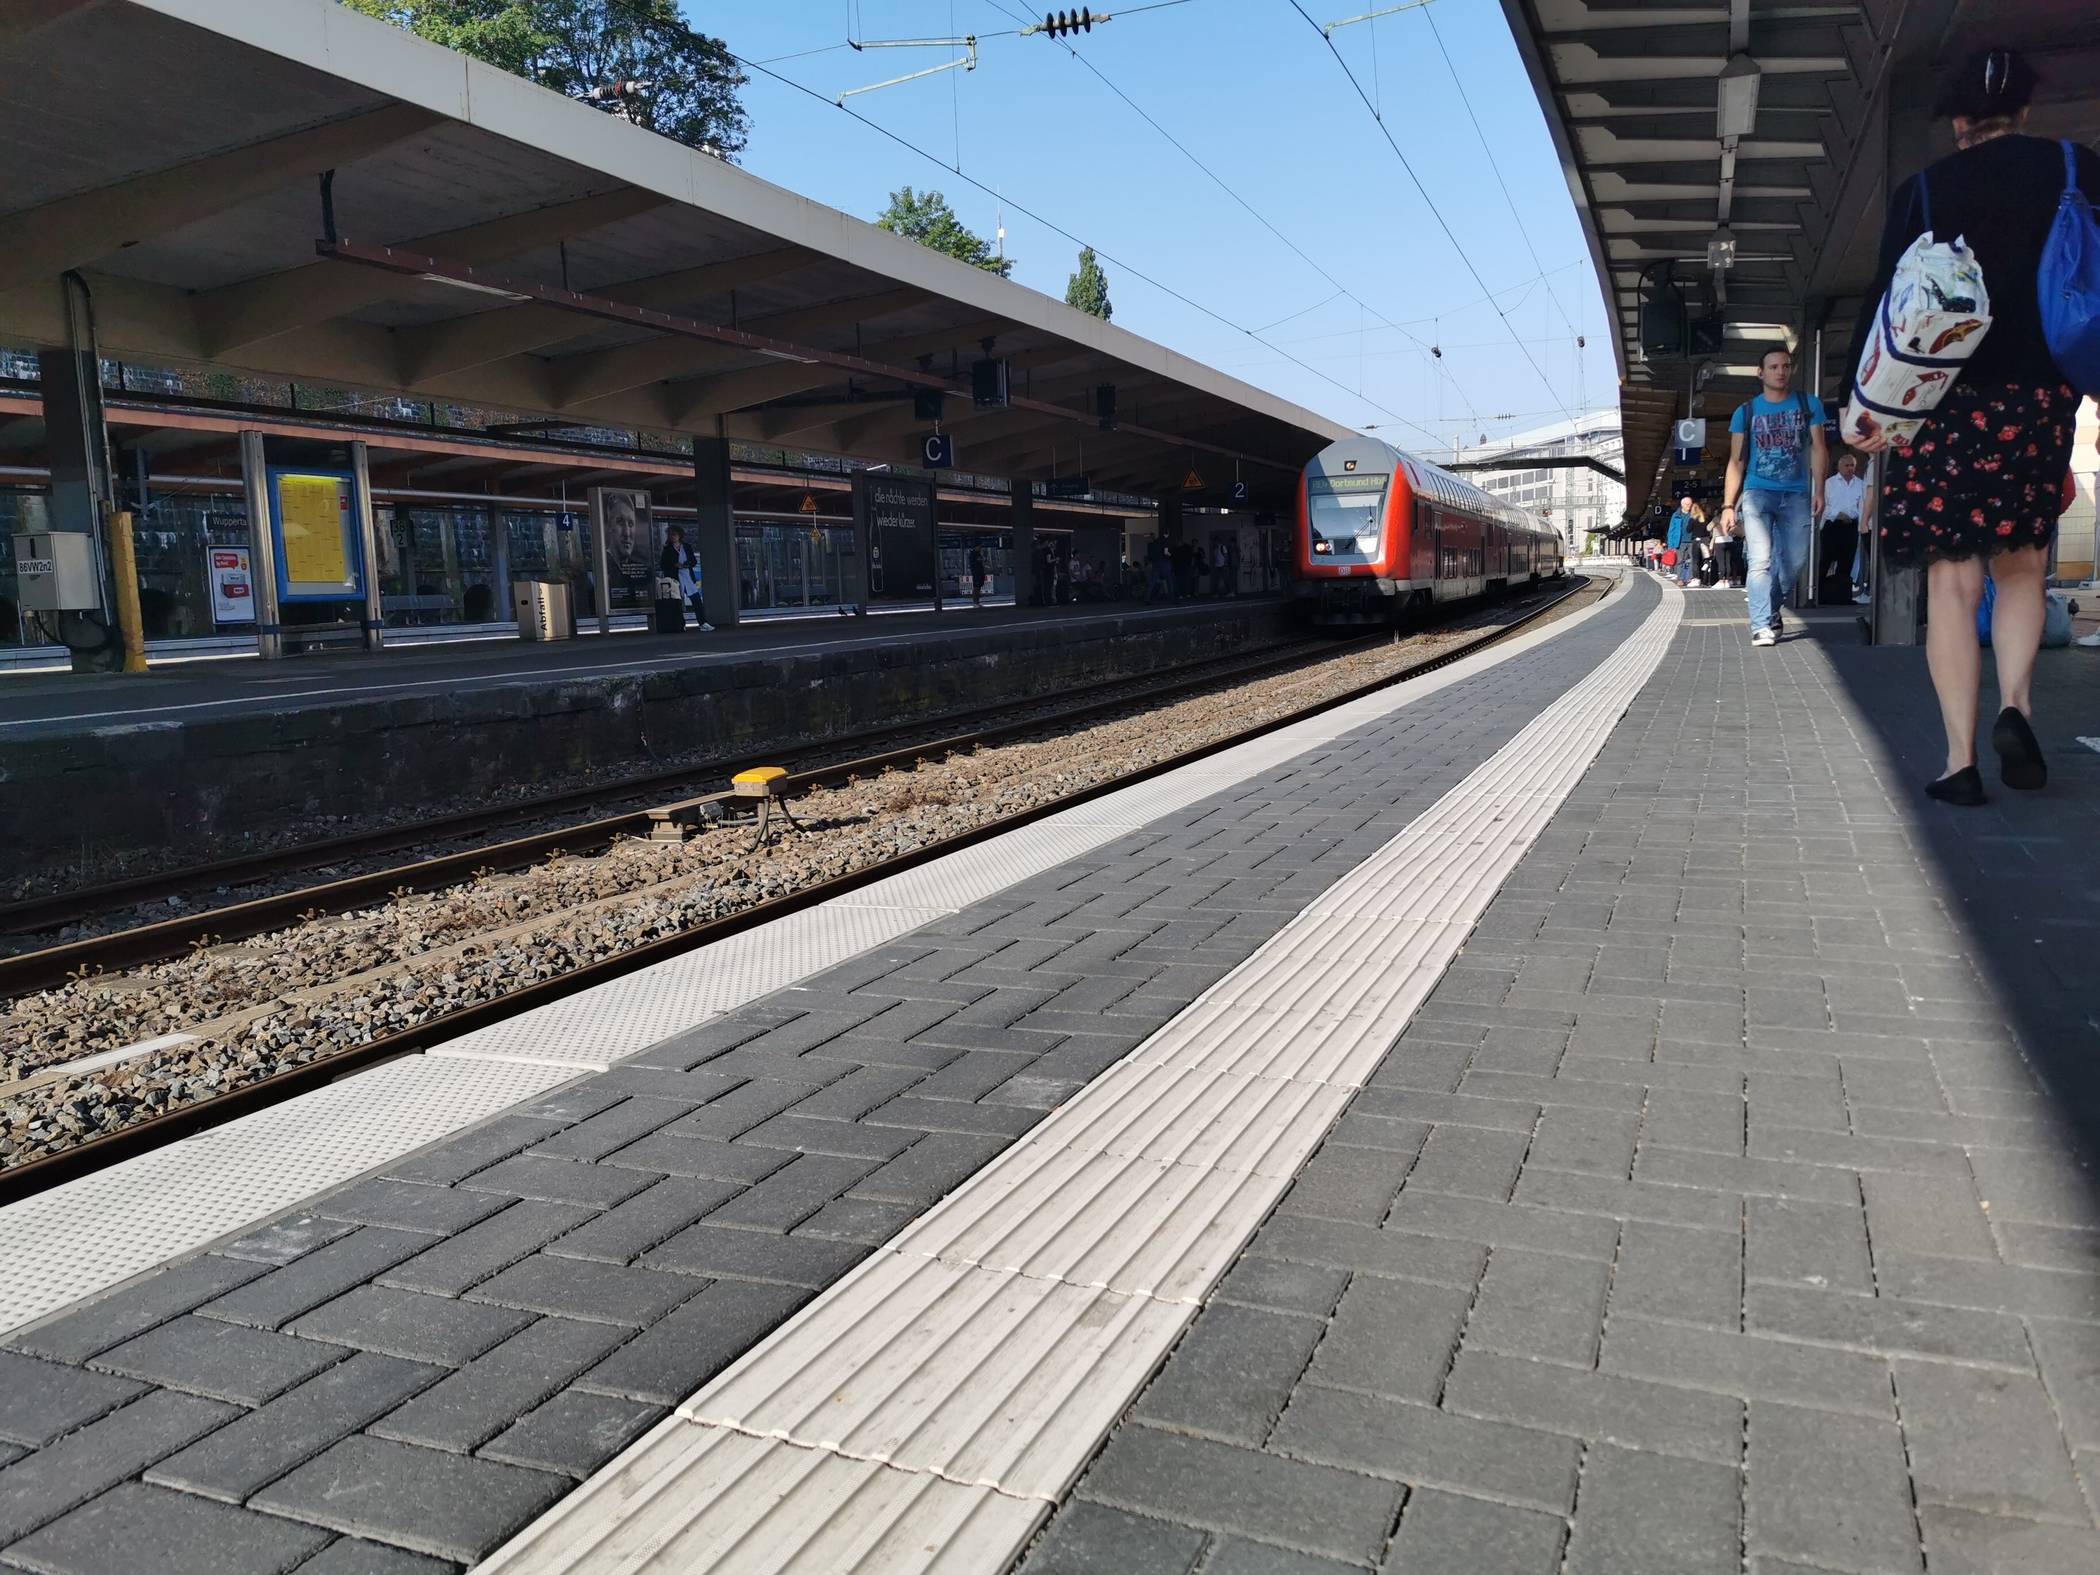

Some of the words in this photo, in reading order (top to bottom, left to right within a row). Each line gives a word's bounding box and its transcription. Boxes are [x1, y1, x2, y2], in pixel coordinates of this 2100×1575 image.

[1679, 421, 1695, 442] C
[926, 436, 941, 461] C
[1235, 482, 1244, 497] 2
[1330, 478, 1368, 488] Dortmund
[875, 487, 885, 503] die
[1654, 505, 1662, 514] D
[212, 516, 248, 528] Wupperta
[562, 513, 570, 527] 4
[877, 512, 898, 527] wieder
[396, 534, 404, 545] 2
[1338, 566, 1352, 576] DB
[537, 597, 548, 631] Abfall
